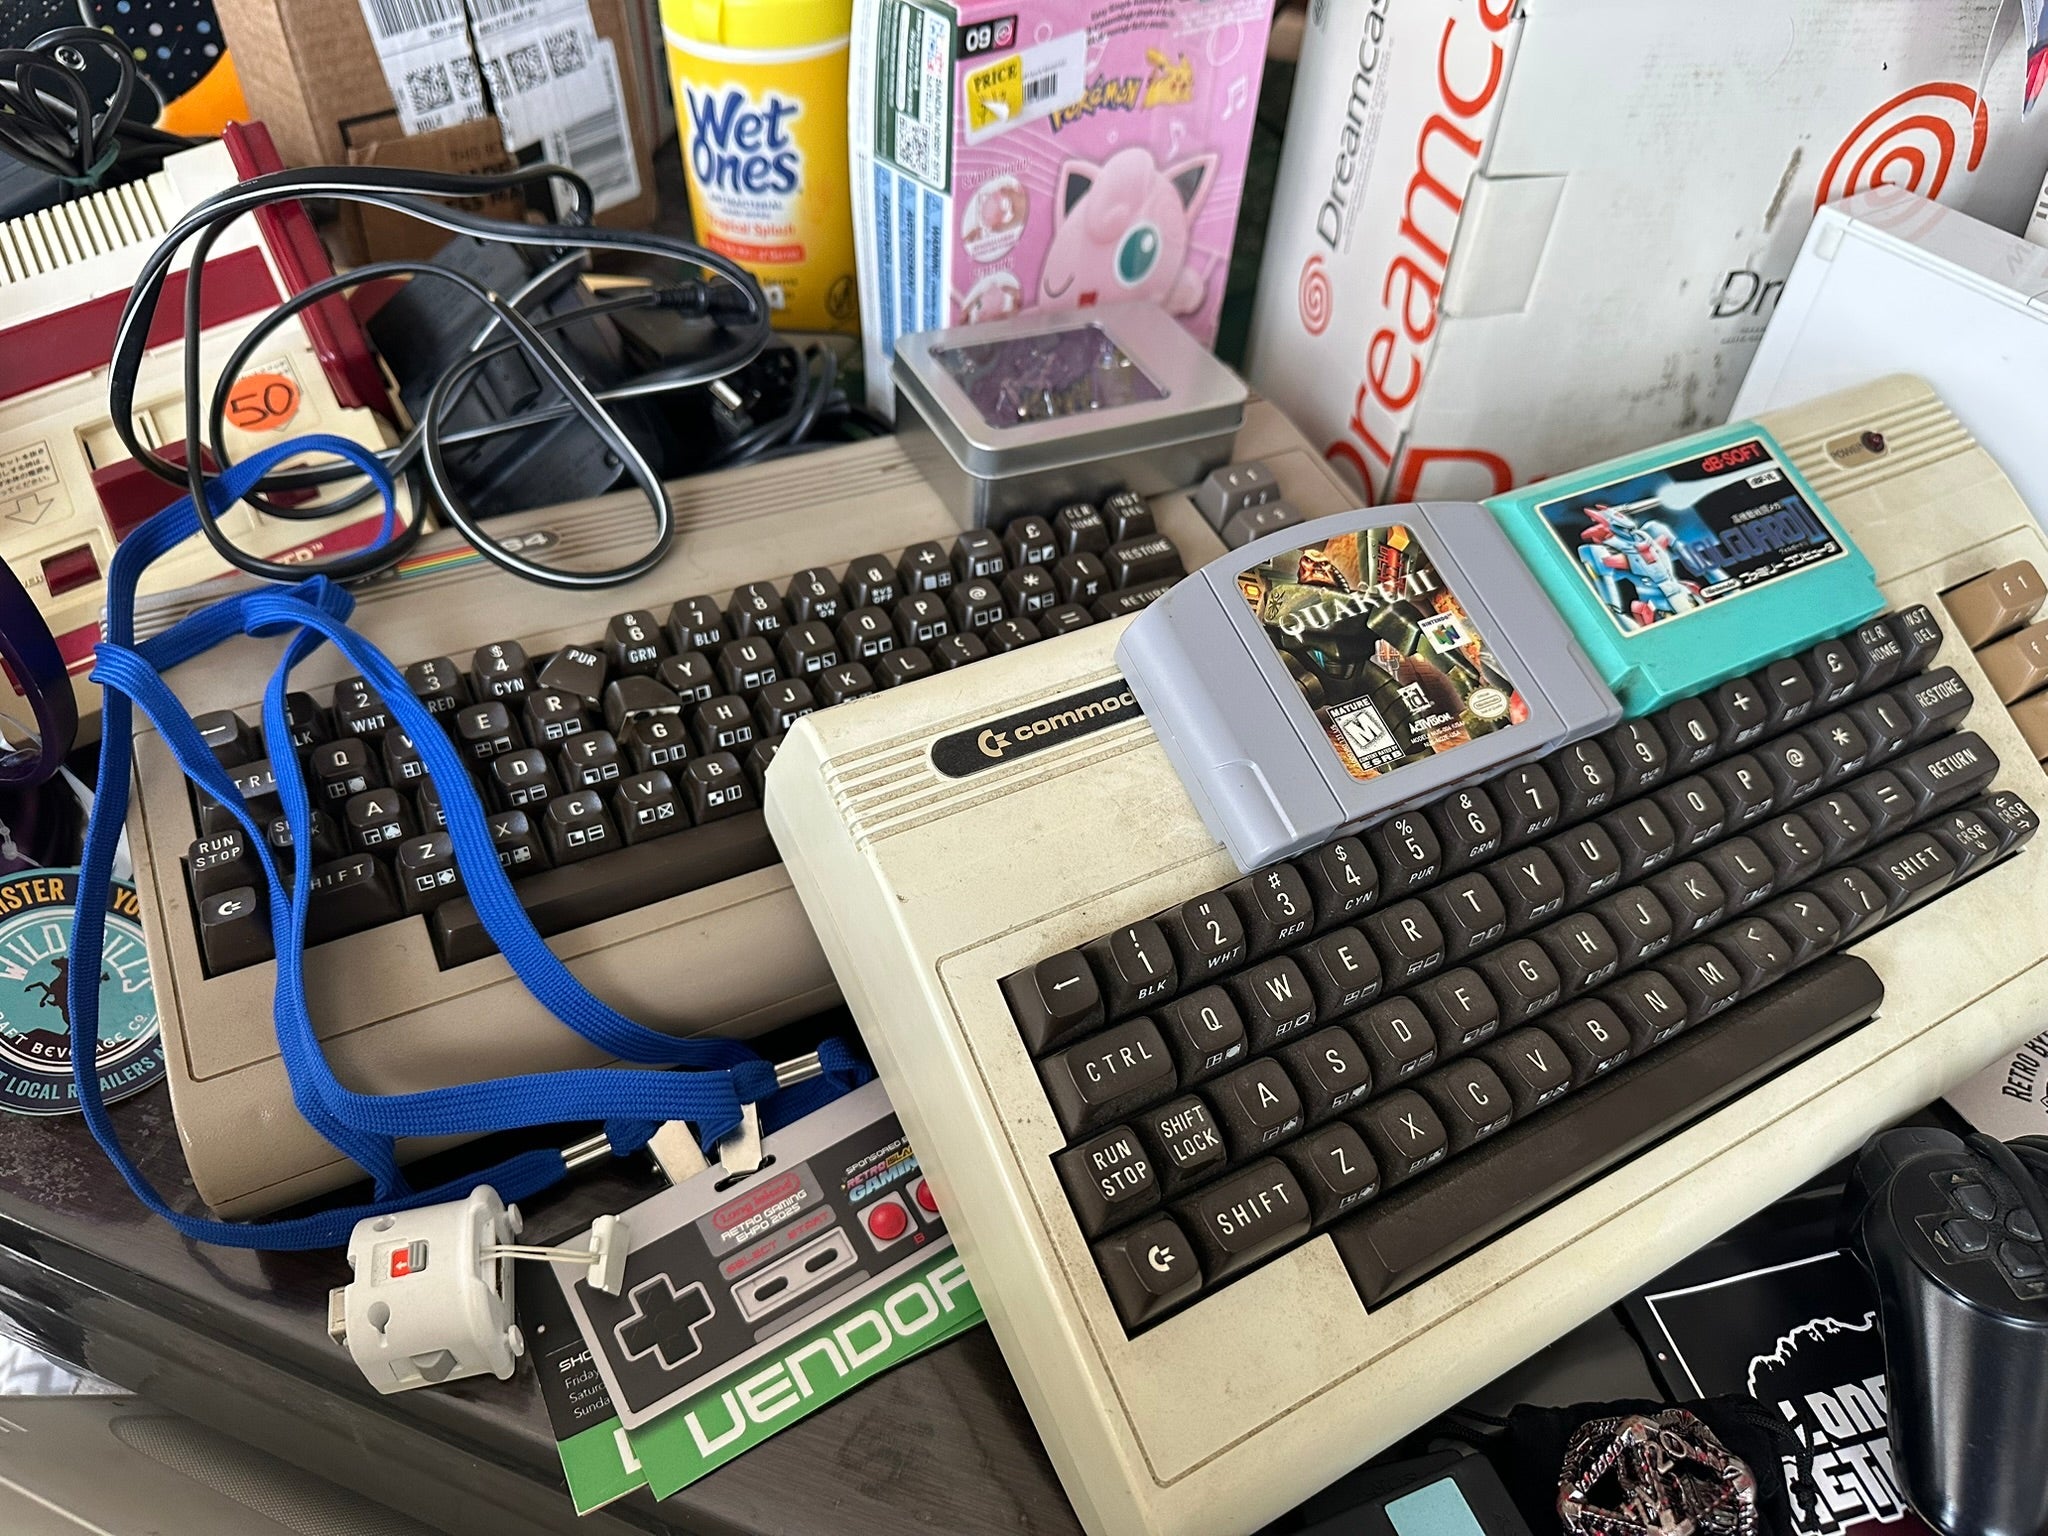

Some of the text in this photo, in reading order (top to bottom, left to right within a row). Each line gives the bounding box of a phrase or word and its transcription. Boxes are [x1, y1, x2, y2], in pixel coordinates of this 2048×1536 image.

[965, 26, 992, 51] 09
[973, 64, 1018, 92] PRICE
[686, 90, 799, 150] Wet
[693, 137, 800, 194] Ones
[230, 382, 294, 428] 50
[1118, 539, 1171, 561] RESTORE
[1705, 580, 1738, 596] Nintendo
[1277, 567, 1442, 644] QUAKE II
[756, 616, 780, 631] YEL
[1903, 608, 1928, 628] INST
[694, 630, 720, 646] BLU
[1860, 624, 1886, 645] CLR
[1914, 625, 1937, 644] DEL
[568, 649, 597, 667] PUR
[628, 647, 657, 663] GRN
[1868, 640, 1901, 663] HOME
[493, 678, 525, 696] CYN
[1915, 677, 1964, 709] RESTORE
[428, 696, 456, 714] RED
[1330, 698, 1371, 718] MATURE
[351, 715, 386, 733] WHT
[1343, 711, 1383, 747] M
[1362, 750, 1402, 768] ESRB
[1635, 742, 1653, 763] 9
[1927, 747, 1979, 780] RETURN
[233, 768, 276, 791] TRL
[1582, 764, 1600, 785] 8
[1736, 769, 1753, 791] P
[1525, 788, 1542, 810] 7
[1585, 792, 1606, 808] YEL
[1687, 791, 1705, 812] O
[1467, 812, 1487, 835] 6
[1997, 801, 2029, 824] CRSR
[1526, 816, 1552, 834] BLU
[1955, 823, 1987, 846] CRSR
[199, 835, 234, 853] RUN
[1405, 837, 1425, 860] 5
[1468, 839, 1496, 857] GRN
[1579, 838, 1600, 861] U
[196, 847, 241, 867] STOP
[1734, 855, 1756, 874] L
[1890, 846, 1941, 881] SHIFT
[309, 863, 365, 890] HIFT
[1344, 864, 1361, 886] 4
[1408, 865, 1435, 884] PUR
[1521, 863, 1542, 886] Y
[1685, 878, 1706, 901] K
[1276, 892, 1295, 916] 3
[1344, 892, 1373, 911] CYN
[1462, 890, 1482, 913] T
[1636, 903, 1651, 925] J
[1206, 920, 1227, 944] 2
[1278, 921, 1305, 940] RED
[1401, 918, 1423, 942] R
[1575, 930, 1598, 954] H
[102, 933, 152, 993] ILL'S
[1137, 950, 1153, 974] 1
[1207, 947, 1240, 968] WHT
[1337, 946, 1358, 971] E
[1518, 959, 1539, 982] G
[1697, 961, 1726, 986] M
[1138, 980, 1167, 999] BLK
[1265, 973, 1293, 1002] W
[1454, 987, 1471, 1012] F
[1644, 989, 1669, 1013] N
[1200, 1007, 1222, 1031] Q
[1391, 1018, 1412, 1043] D
[1586, 1019, 1609, 1042] B
[1085, 1041, 1153, 1082] CTRL
[1325, 1049, 1347, 1074] S
[1525, 1048, 1549, 1073] V
[5, 1056, 156, 1100] LOCAL RAILERS
[2002, 1053, 2040, 1103] RETRO
[1256, 1082, 1279, 1108] A
[1467, 1082, 1489, 1106] C
[1160, 1105, 1206, 1139] SHIFT
[1399, 1112, 1425, 1140] X
[1092, 1139, 1133, 1171] RUN
[1172, 1128, 1219, 1162] LOCK
[845, 1140, 902, 1175] SPONSORED
[1330, 1147, 1356, 1175] Z
[846, 1161, 887, 1189] RETRO
[1101, 1160, 1147, 1198] STOP
[720, 1189, 808, 1242] RETRO GAMING
[771, 1203, 802, 1227] 2025
[1216, 1183, 1292, 1236] SHIFT
[726, 1211, 829, 1275] SELECT START
[914, 1234, 926, 1244] B
